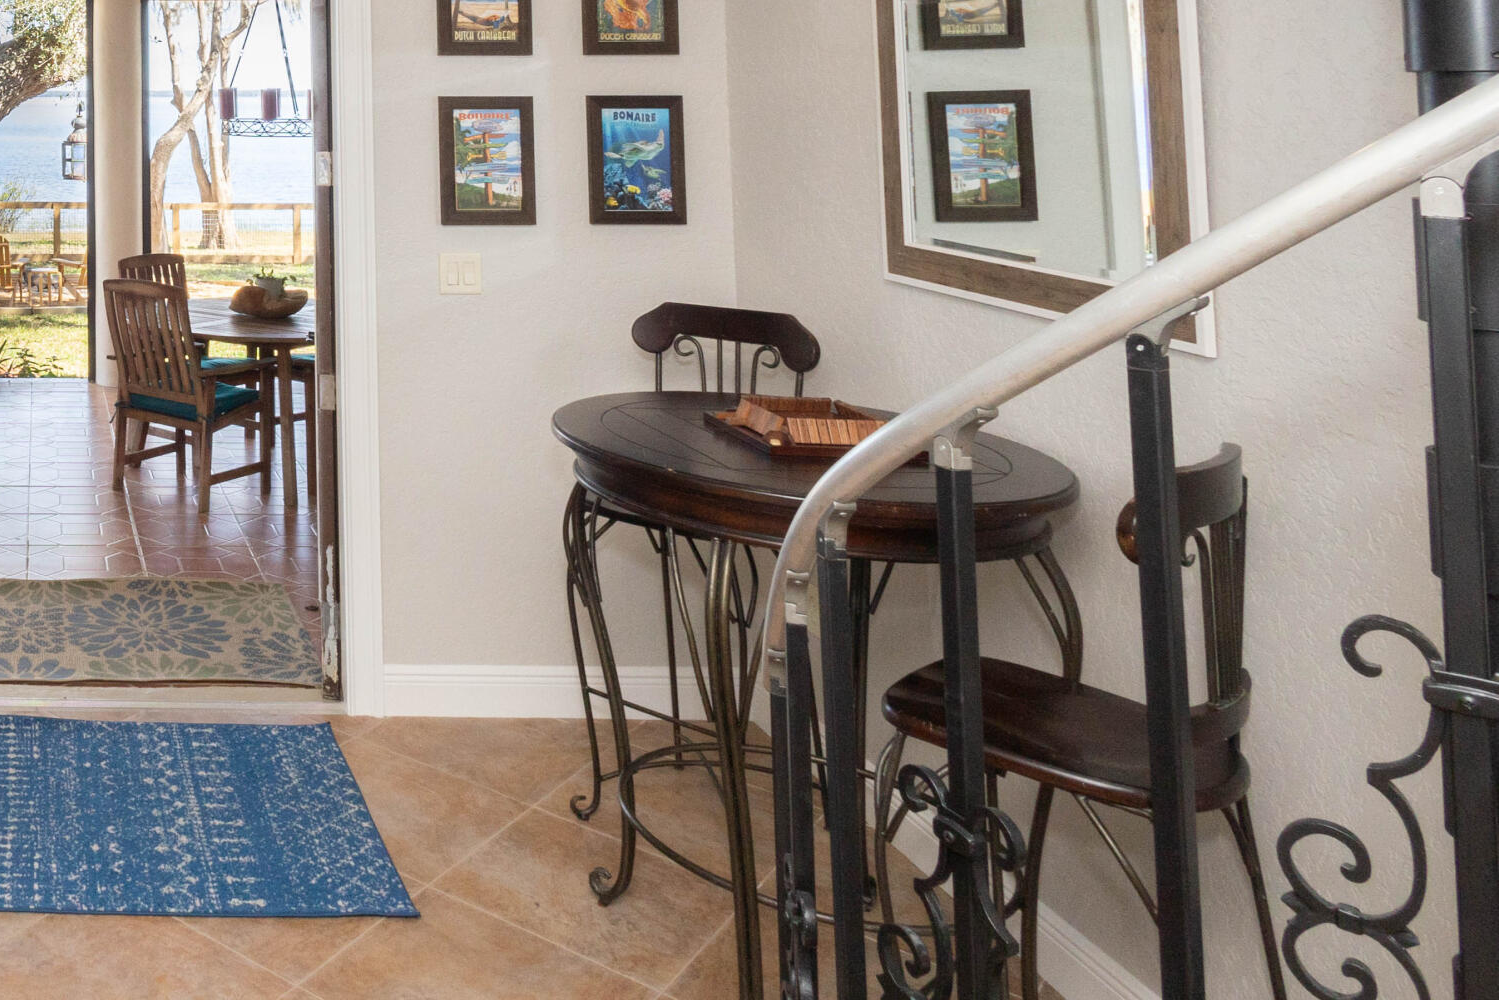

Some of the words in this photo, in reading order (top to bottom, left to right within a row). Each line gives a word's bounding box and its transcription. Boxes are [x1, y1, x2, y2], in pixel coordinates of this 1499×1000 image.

[454, 30, 474, 41] DUTCH
[458, 112, 513, 121] BONAIRE
[613, 111, 657, 122] BONAIRE
